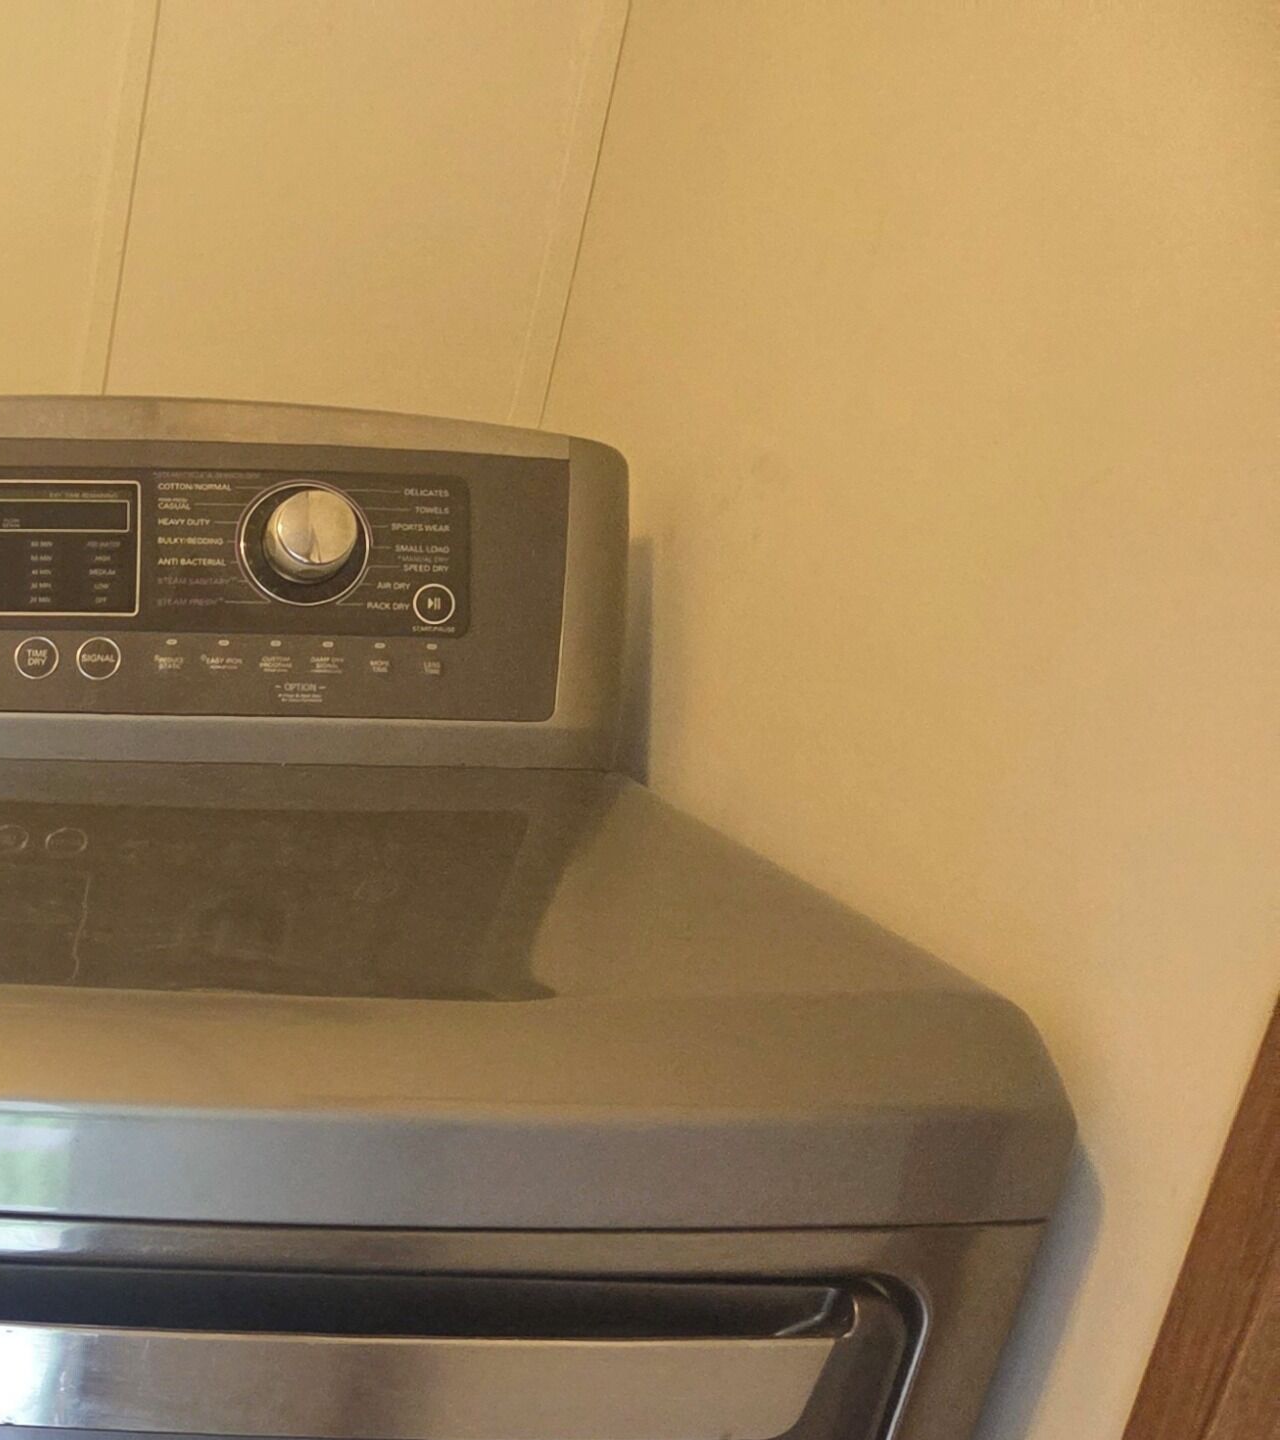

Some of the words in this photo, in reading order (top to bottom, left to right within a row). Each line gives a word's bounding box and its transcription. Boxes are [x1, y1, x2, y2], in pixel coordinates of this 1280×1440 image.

[403, 488, 450, 497] DELICATES
[415, 506, 450, 515] TOWELS
[403, 564, 430, 572] SPEED
[432, 564, 449, 572] DRY
[393, 582, 411, 590] DRY
[393, 602, 410, 610] DRY
[27, 649, 48, 657] TIME
[27, 657, 47, 666] DRY
[81, 653, 115, 663] SIGNAL
